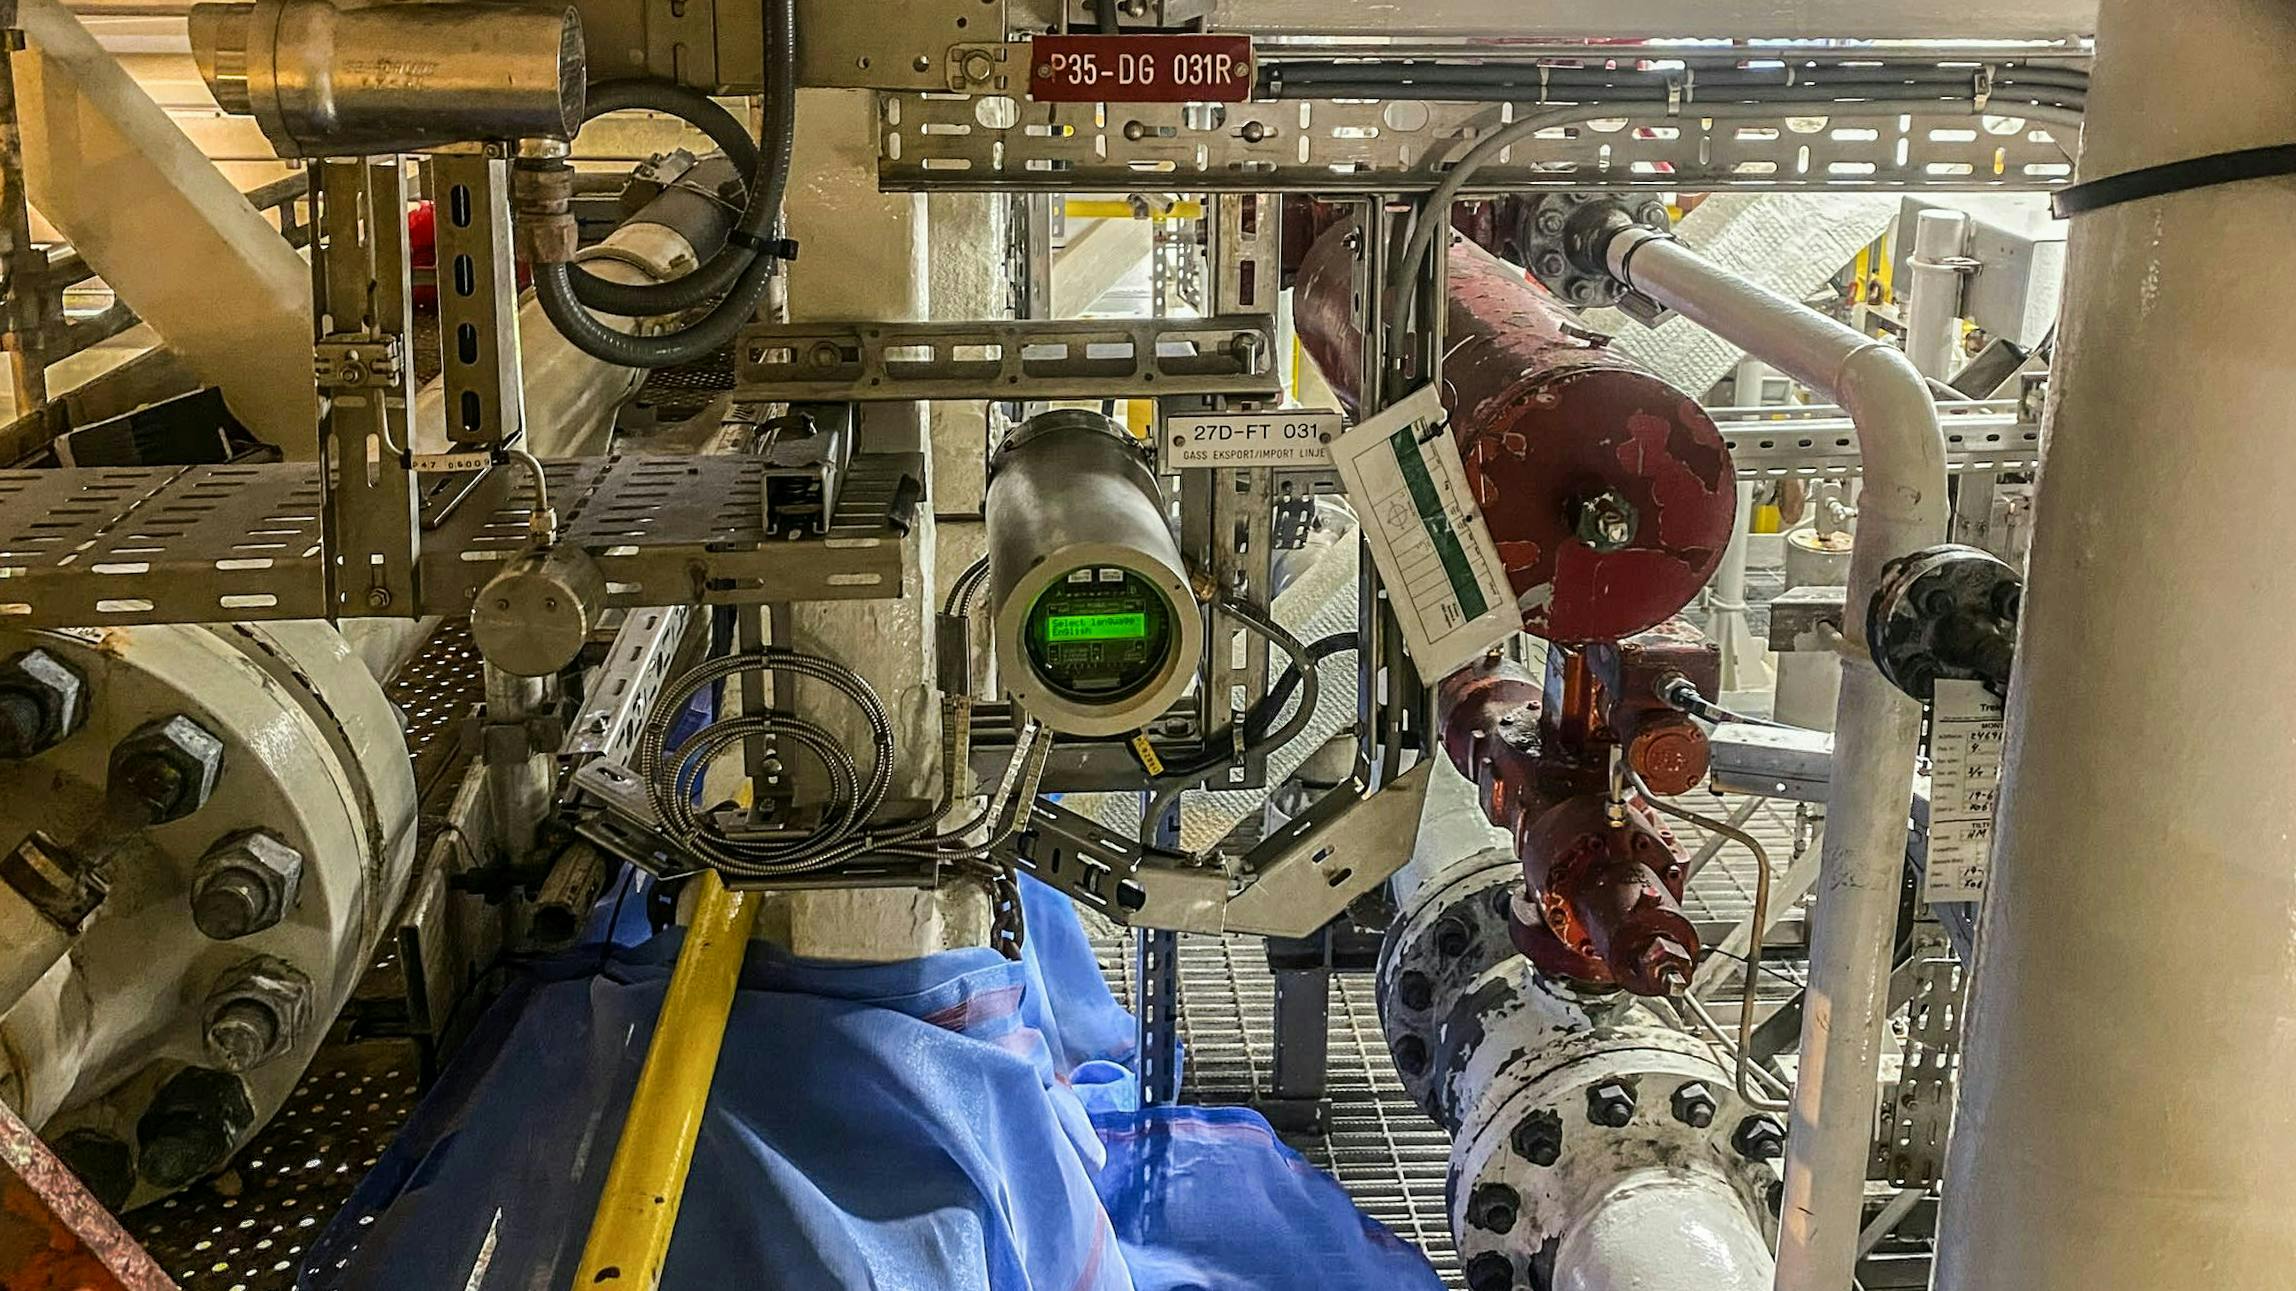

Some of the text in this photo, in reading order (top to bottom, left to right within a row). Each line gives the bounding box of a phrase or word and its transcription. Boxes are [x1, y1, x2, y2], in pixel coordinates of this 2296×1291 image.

[1051, 54, 1231, 85] P35-DG 031R
[1194, 423, 1317, 440] 27D-FT 031
[1183, 448, 1325, 460] GASS EKSPORT/IMPORT LINJE
